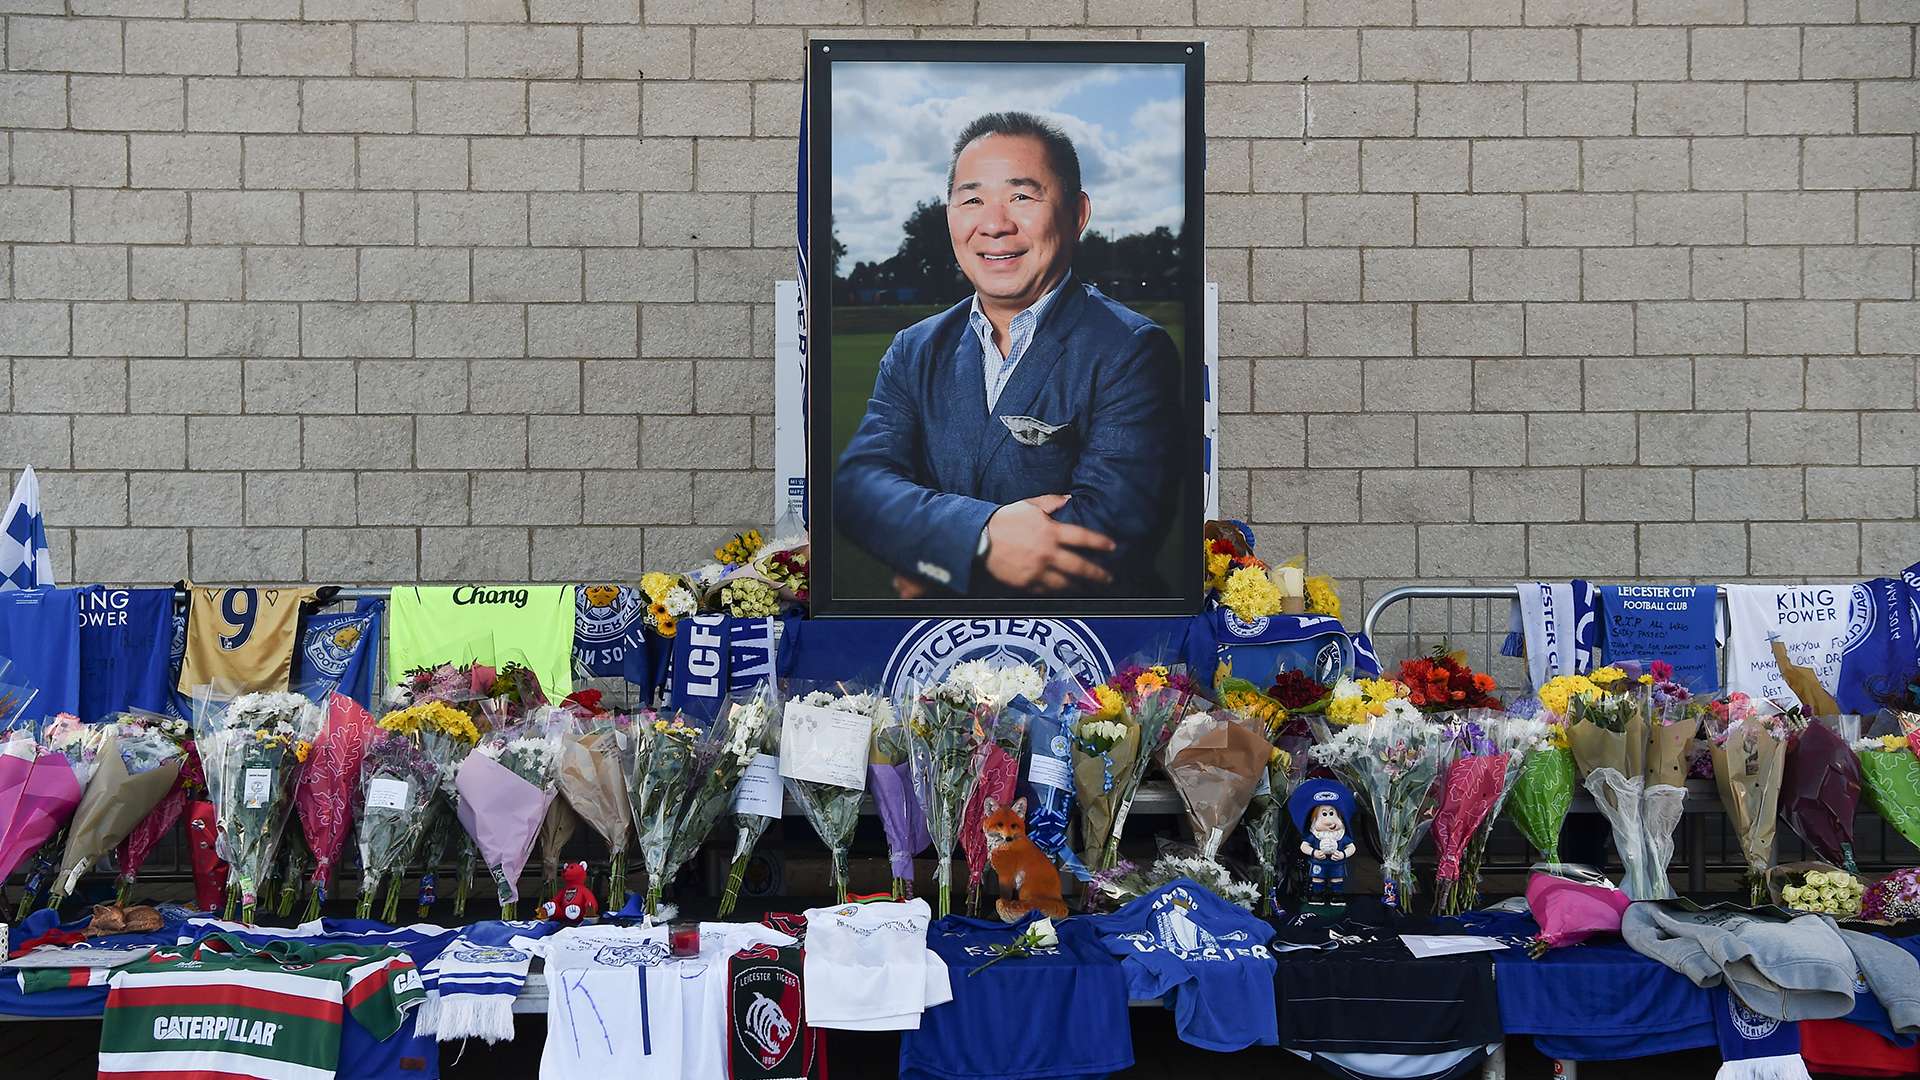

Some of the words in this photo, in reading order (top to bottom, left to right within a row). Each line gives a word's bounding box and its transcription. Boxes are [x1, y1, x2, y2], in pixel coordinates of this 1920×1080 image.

[81, 591, 129, 610] ING
[453, 584, 529, 607] Chang
[1618, 586, 1670, 597] LEICESTER
[1672, 587, 1697, 598] CITY
[1776, 589, 1834, 610] KING
[1540, 584, 1556, 646] ESTER
[1623, 600, 1665, 611] FOOTBALL
[1666, 601, 1688, 611] CLUB
[1778, 608, 1837, 624] POWER
[80, 611, 128, 627] OWER
[219, 588, 259, 650] 9
[906, 618, 1053, 685] EICESTER
[394, 968, 425, 995] CA
[740, 972, 771, 987] LEICESTER
[776, 972, 796, 987] TIGERS
[153, 1016, 277, 1047] CATERPILLAR
